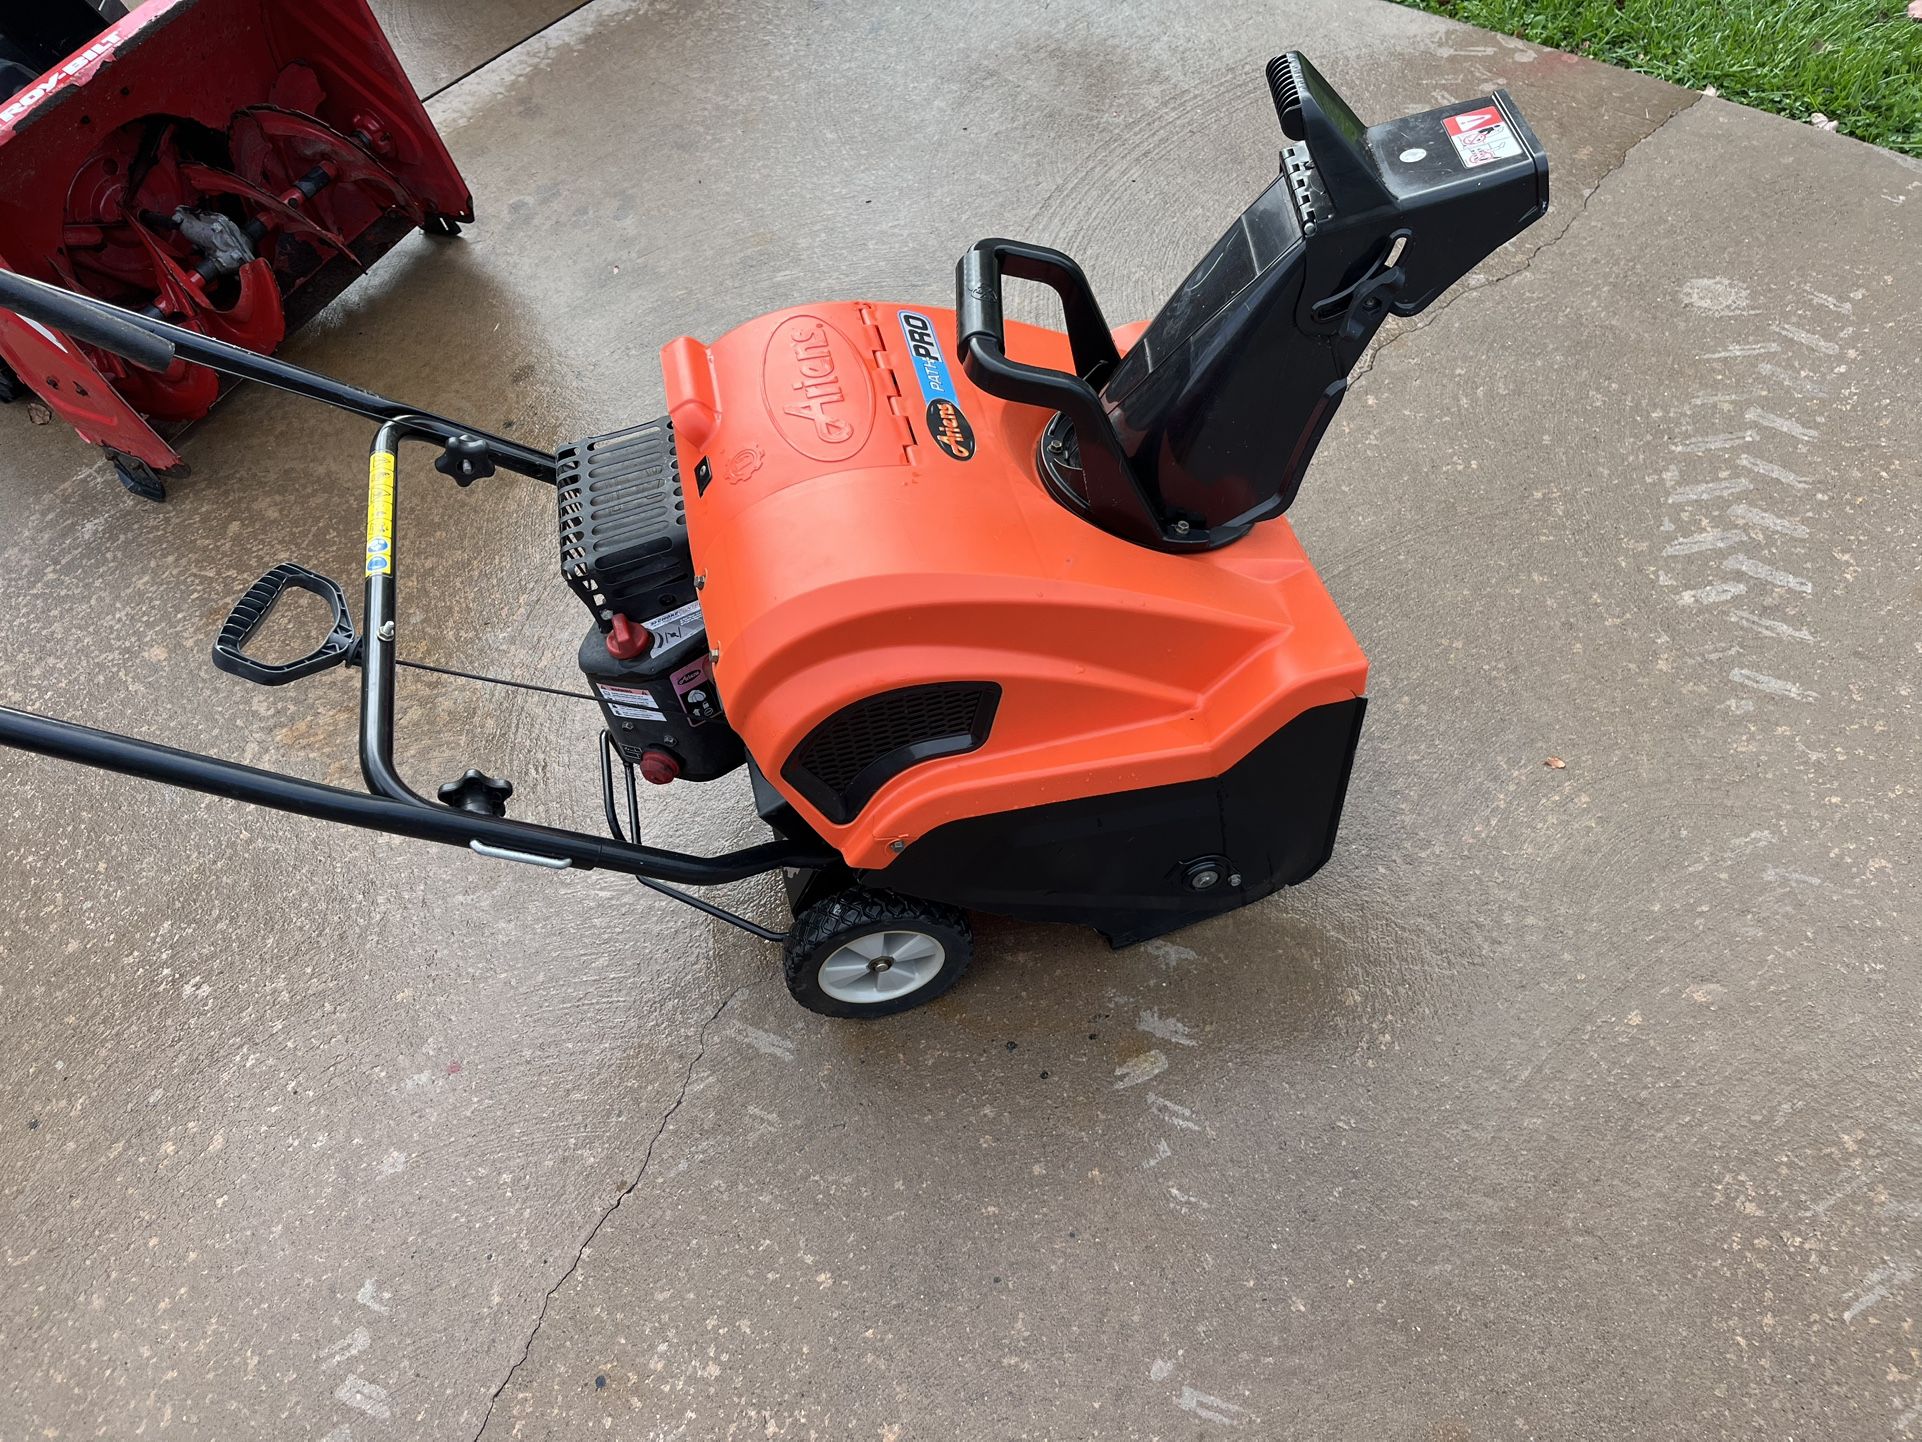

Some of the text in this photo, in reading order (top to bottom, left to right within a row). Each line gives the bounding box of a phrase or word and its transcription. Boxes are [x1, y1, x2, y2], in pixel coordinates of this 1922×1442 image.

[0, 31, 122, 130] ROY-BILT
[783, 322, 855, 443] Ariens
[903, 314, 945, 391] PATH PRO
[936, 402, 972, 458] Ariens
